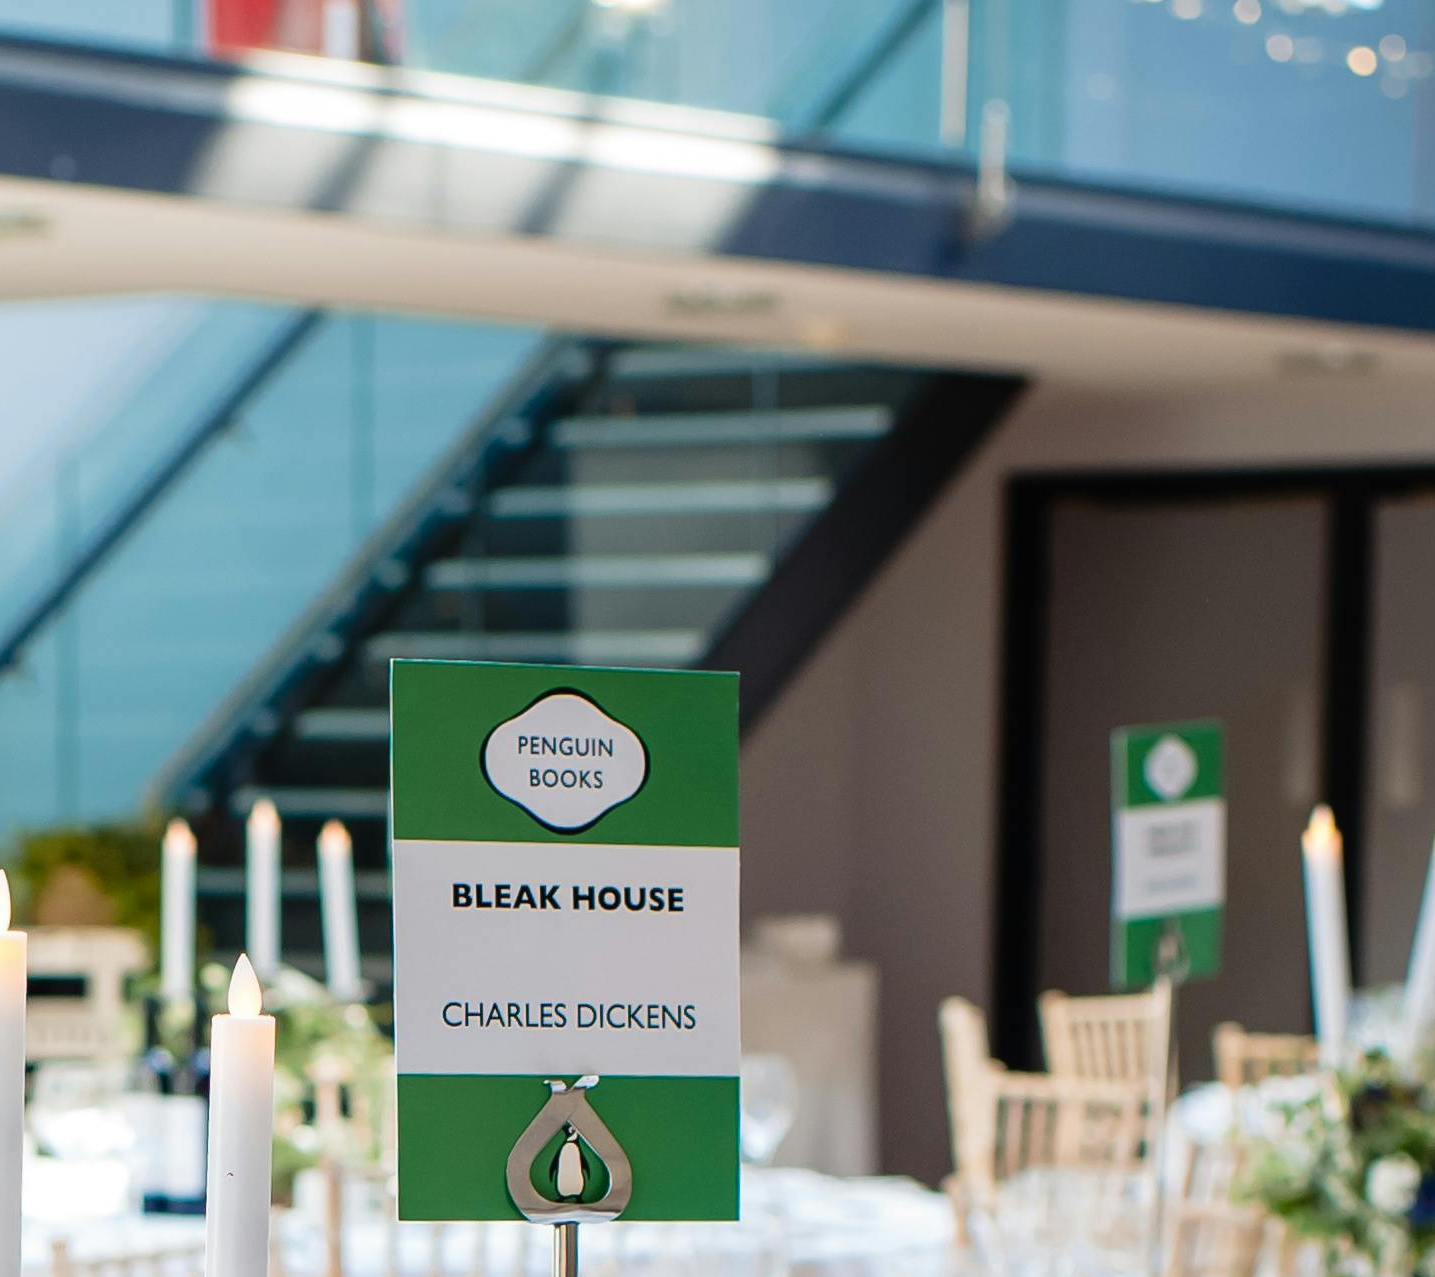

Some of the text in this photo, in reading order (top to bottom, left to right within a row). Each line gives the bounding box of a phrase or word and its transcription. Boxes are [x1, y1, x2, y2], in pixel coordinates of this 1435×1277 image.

[517, 735, 614, 759] PENGUIN
[529, 768, 604, 789] BOOKS
[451, 882, 685, 913] BLEAK HOUSE
[442, 1001, 697, 1030] CHARLES DICKENS
